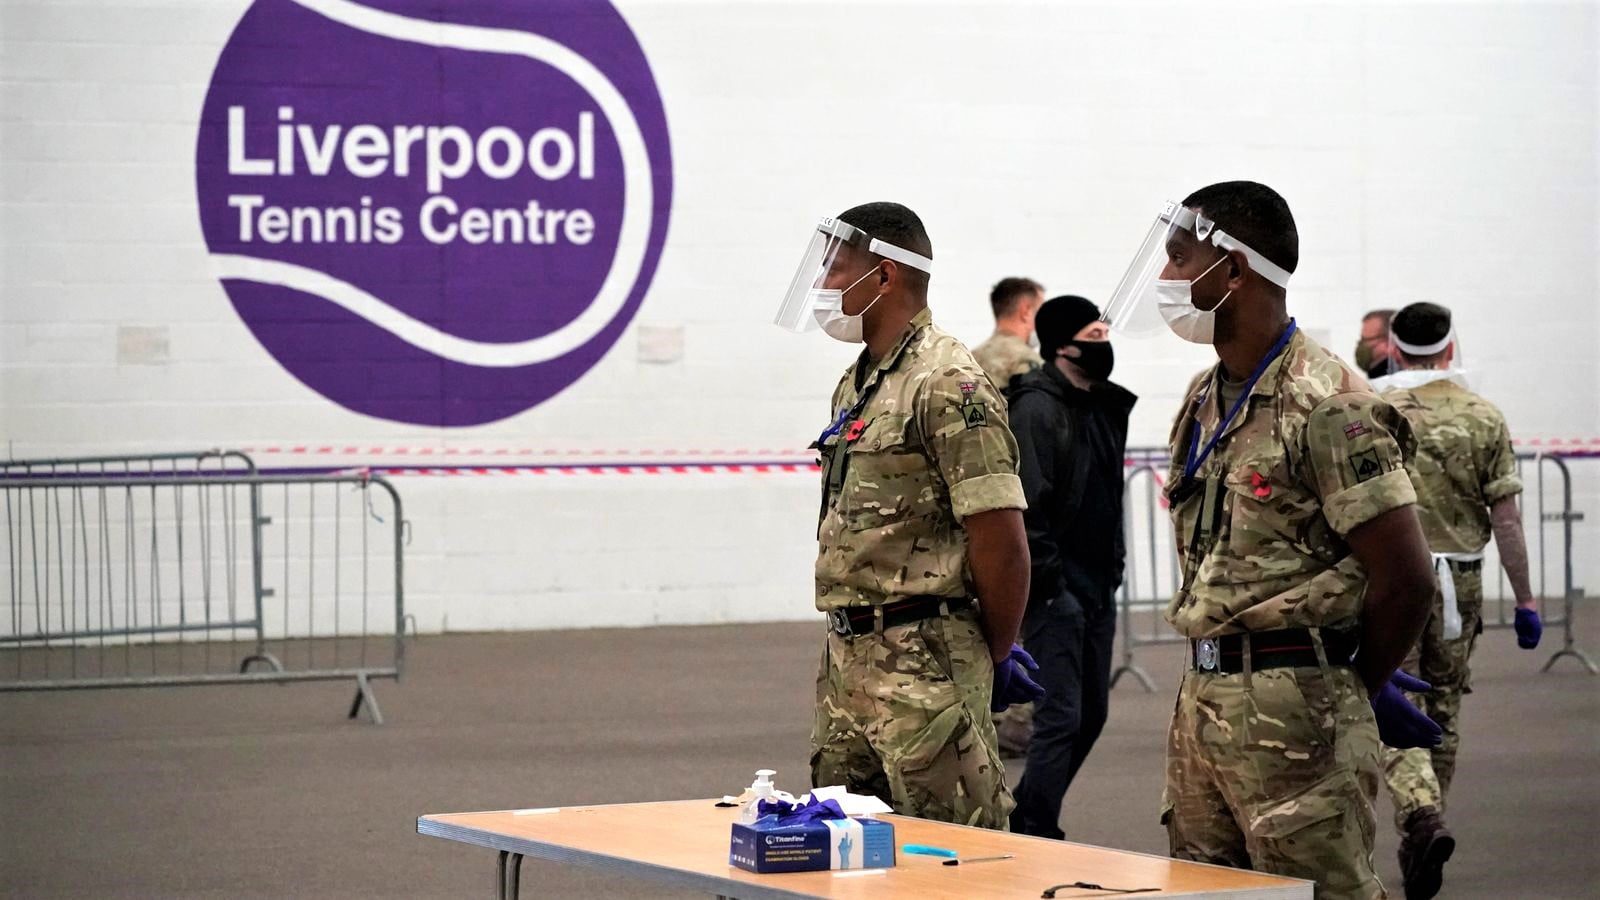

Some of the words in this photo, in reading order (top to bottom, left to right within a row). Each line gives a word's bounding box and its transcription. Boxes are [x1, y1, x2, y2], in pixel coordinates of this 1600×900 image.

[228, 106, 595, 194] Liverpool
[228, 194, 403, 244] Tennis
[419, 195, 595, 245] Centre
